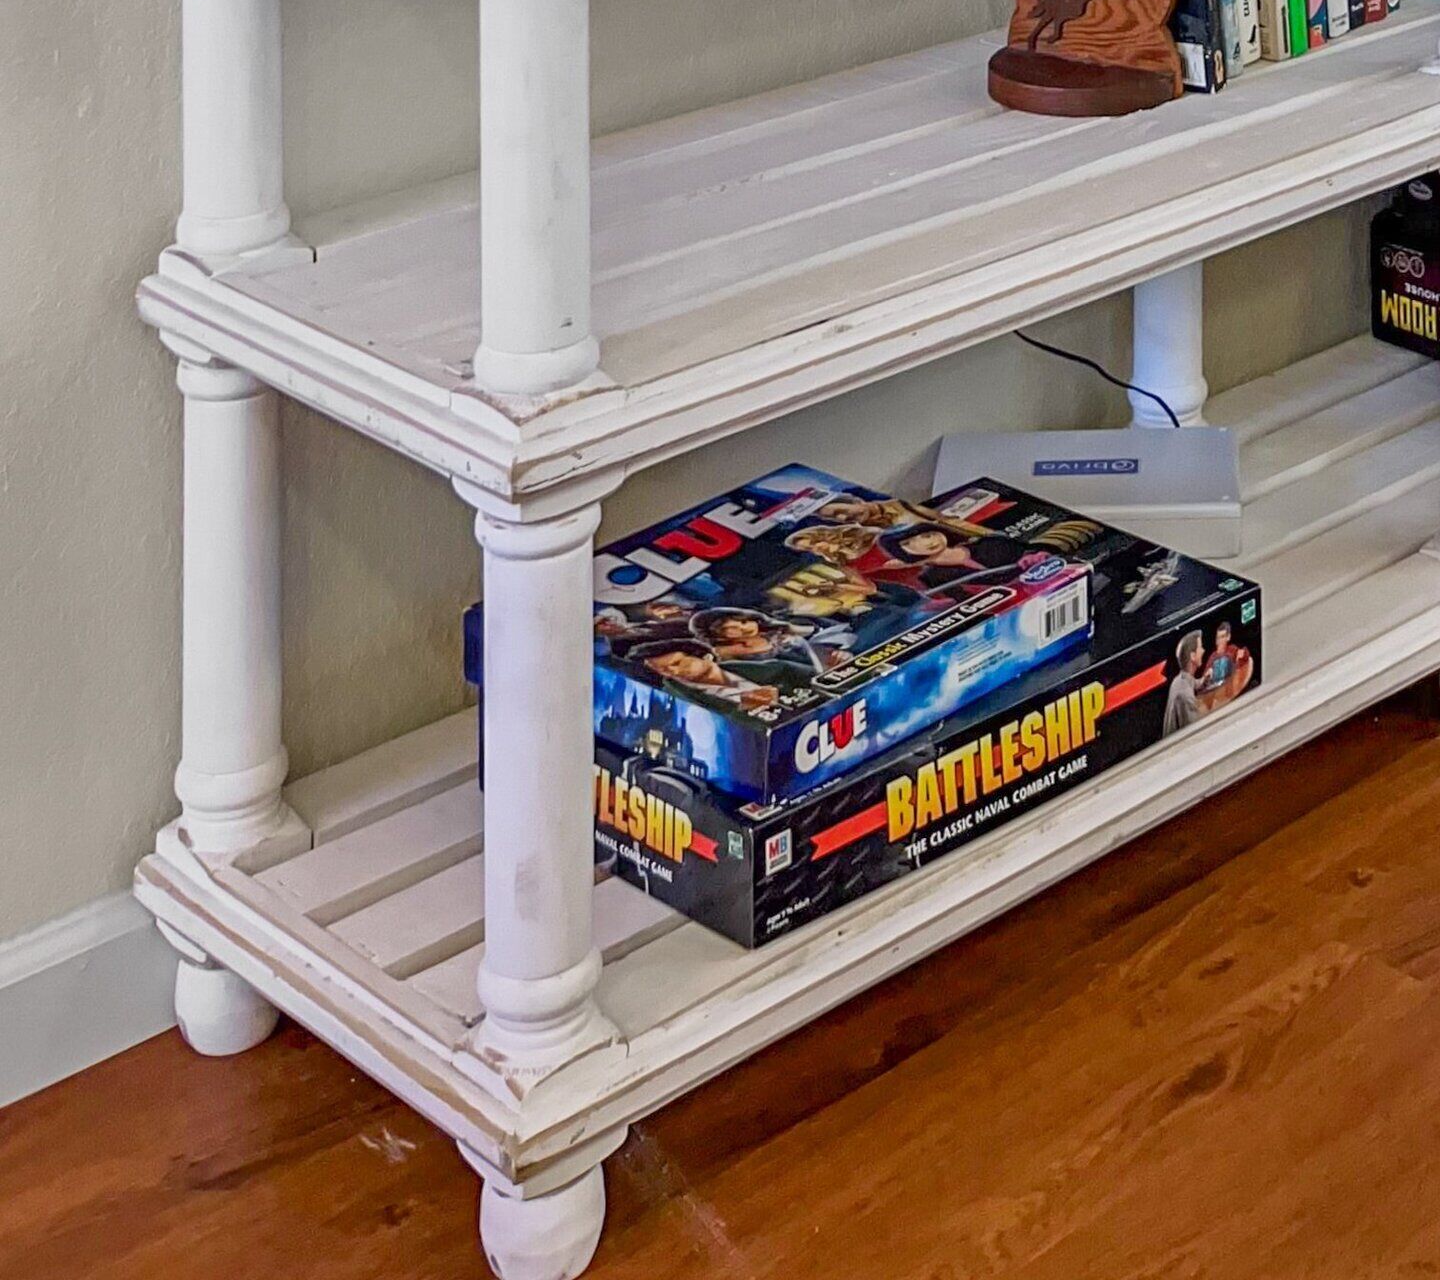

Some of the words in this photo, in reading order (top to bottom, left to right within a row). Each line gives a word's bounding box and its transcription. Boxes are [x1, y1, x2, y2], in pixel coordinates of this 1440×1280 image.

[1381, 289, 1438, 340] ROOM
[593, 502, 779, 605] CLUE
[824, 664, 858, 682] The
[854, 642, 902, 668] Classic
[902, 609, 965, 649] Mystery
[965, 590, 1005, 614] Game
[794, 698, 867, 774] CLUE
[885, 680, 1106, 844] BATTLESHIP
[593, 763, 693, 864] TLESHIP
[769, 835, 788, 860] MB
[904, 839, 928, 859] THE
[930, 813, 973, 848] CLASSIC
[974, 795, 1012, 825] NAVAL
[1012, 771, 1057, 804] COMBAT
[1057, 755, 1089, 780] GAME
[619, 843, 650, 868] COMBAT
[650, 861, 673, 884] GAME
